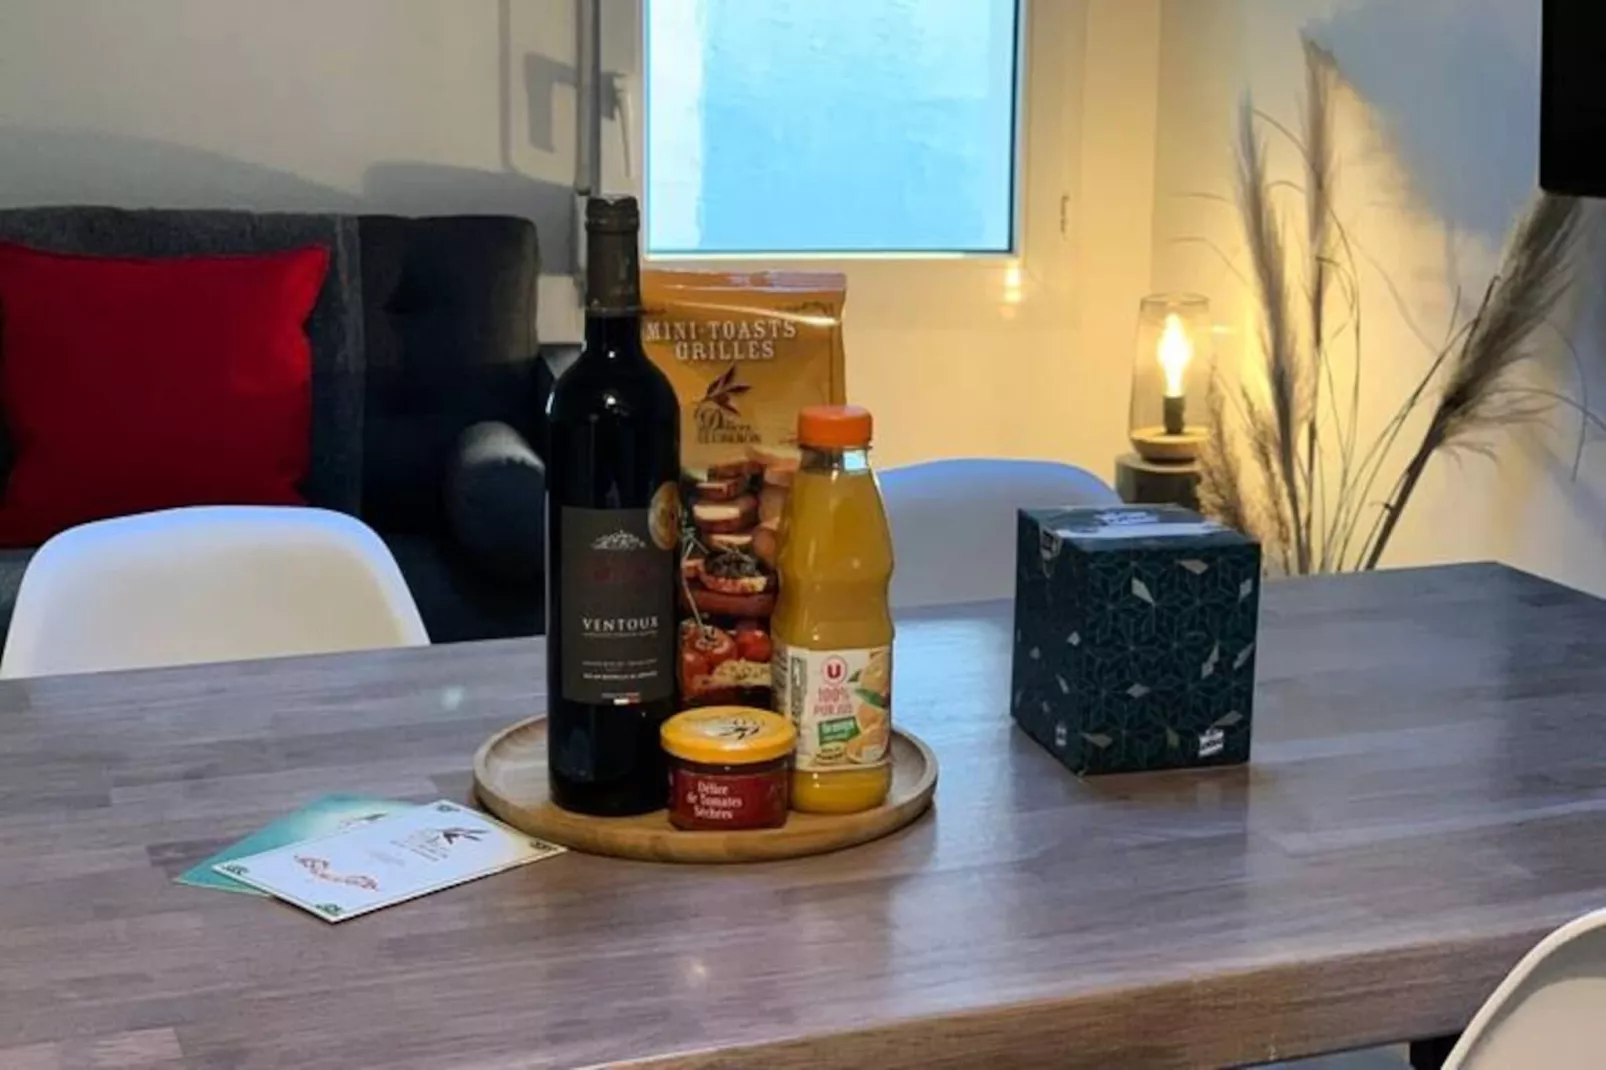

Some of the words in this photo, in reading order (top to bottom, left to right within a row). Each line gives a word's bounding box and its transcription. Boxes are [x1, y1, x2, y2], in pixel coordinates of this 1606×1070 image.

[646, 320, 697, 341] MINI
[708, 318, 797, 340] TOASTS
[582, 615, 659, 632] VENTOUX
[826, 663, 842, 680] U
